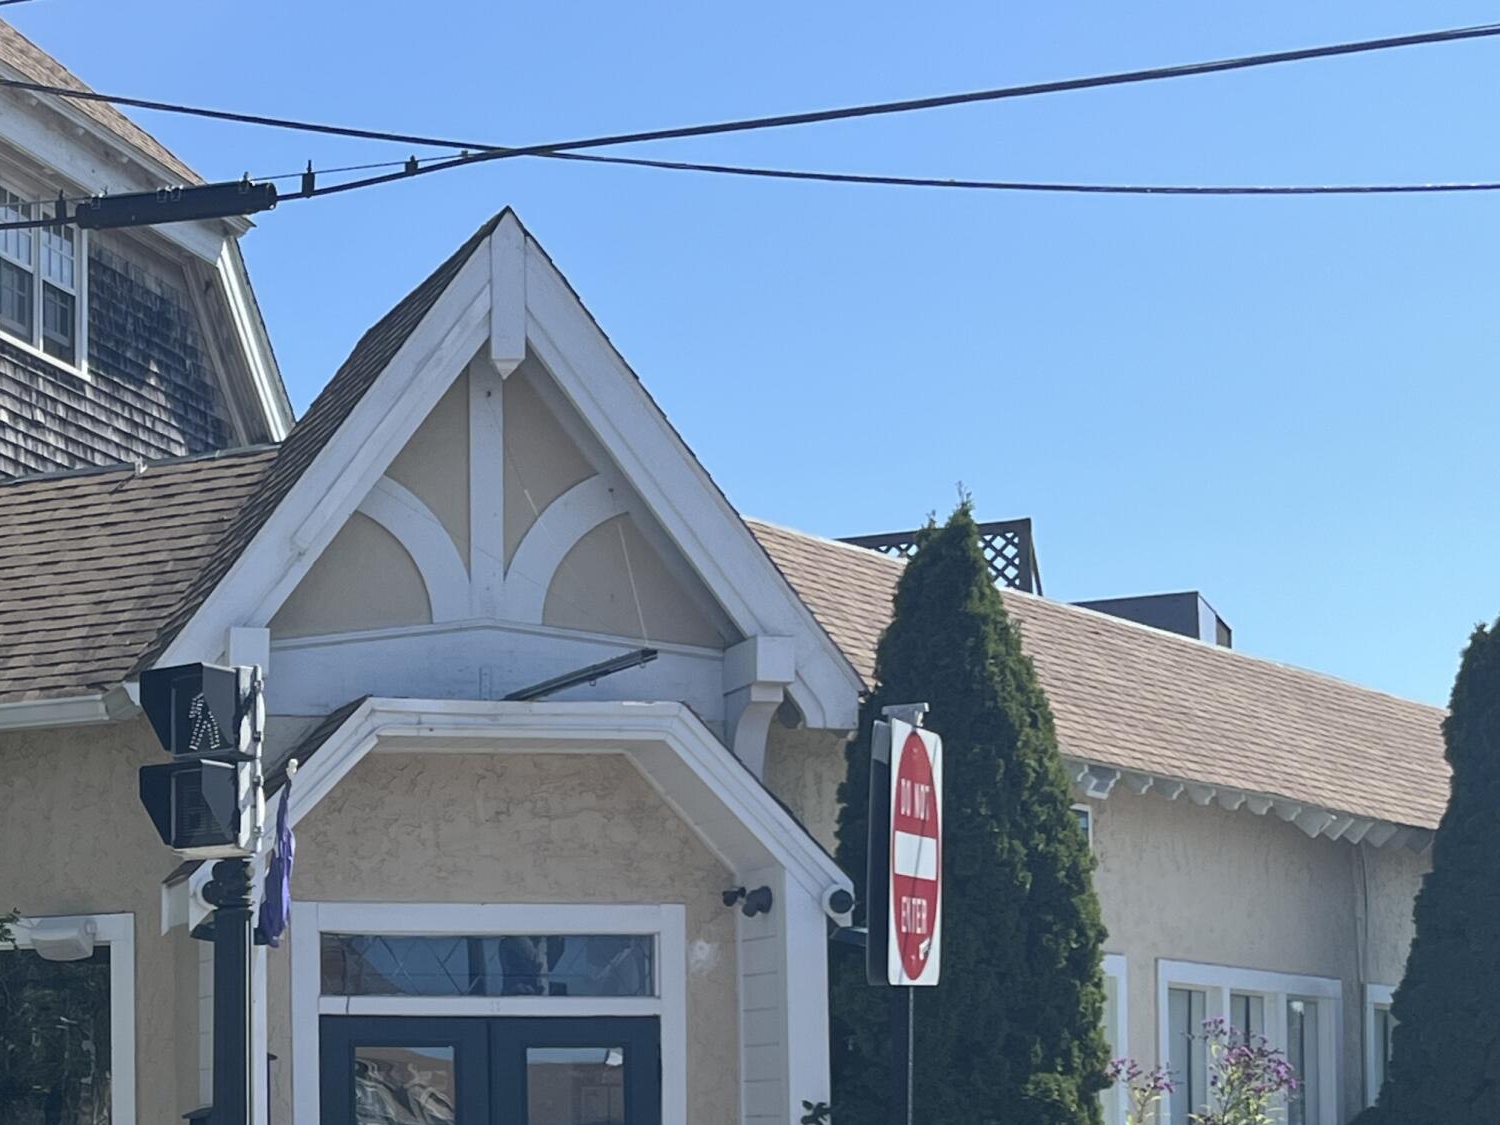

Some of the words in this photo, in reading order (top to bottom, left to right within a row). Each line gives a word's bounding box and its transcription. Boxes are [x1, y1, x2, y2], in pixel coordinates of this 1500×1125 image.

[900, 778, 911, 816] DO
[914, 783, 930, 821] NOT
[901, 896, 927, 934] ENTER
